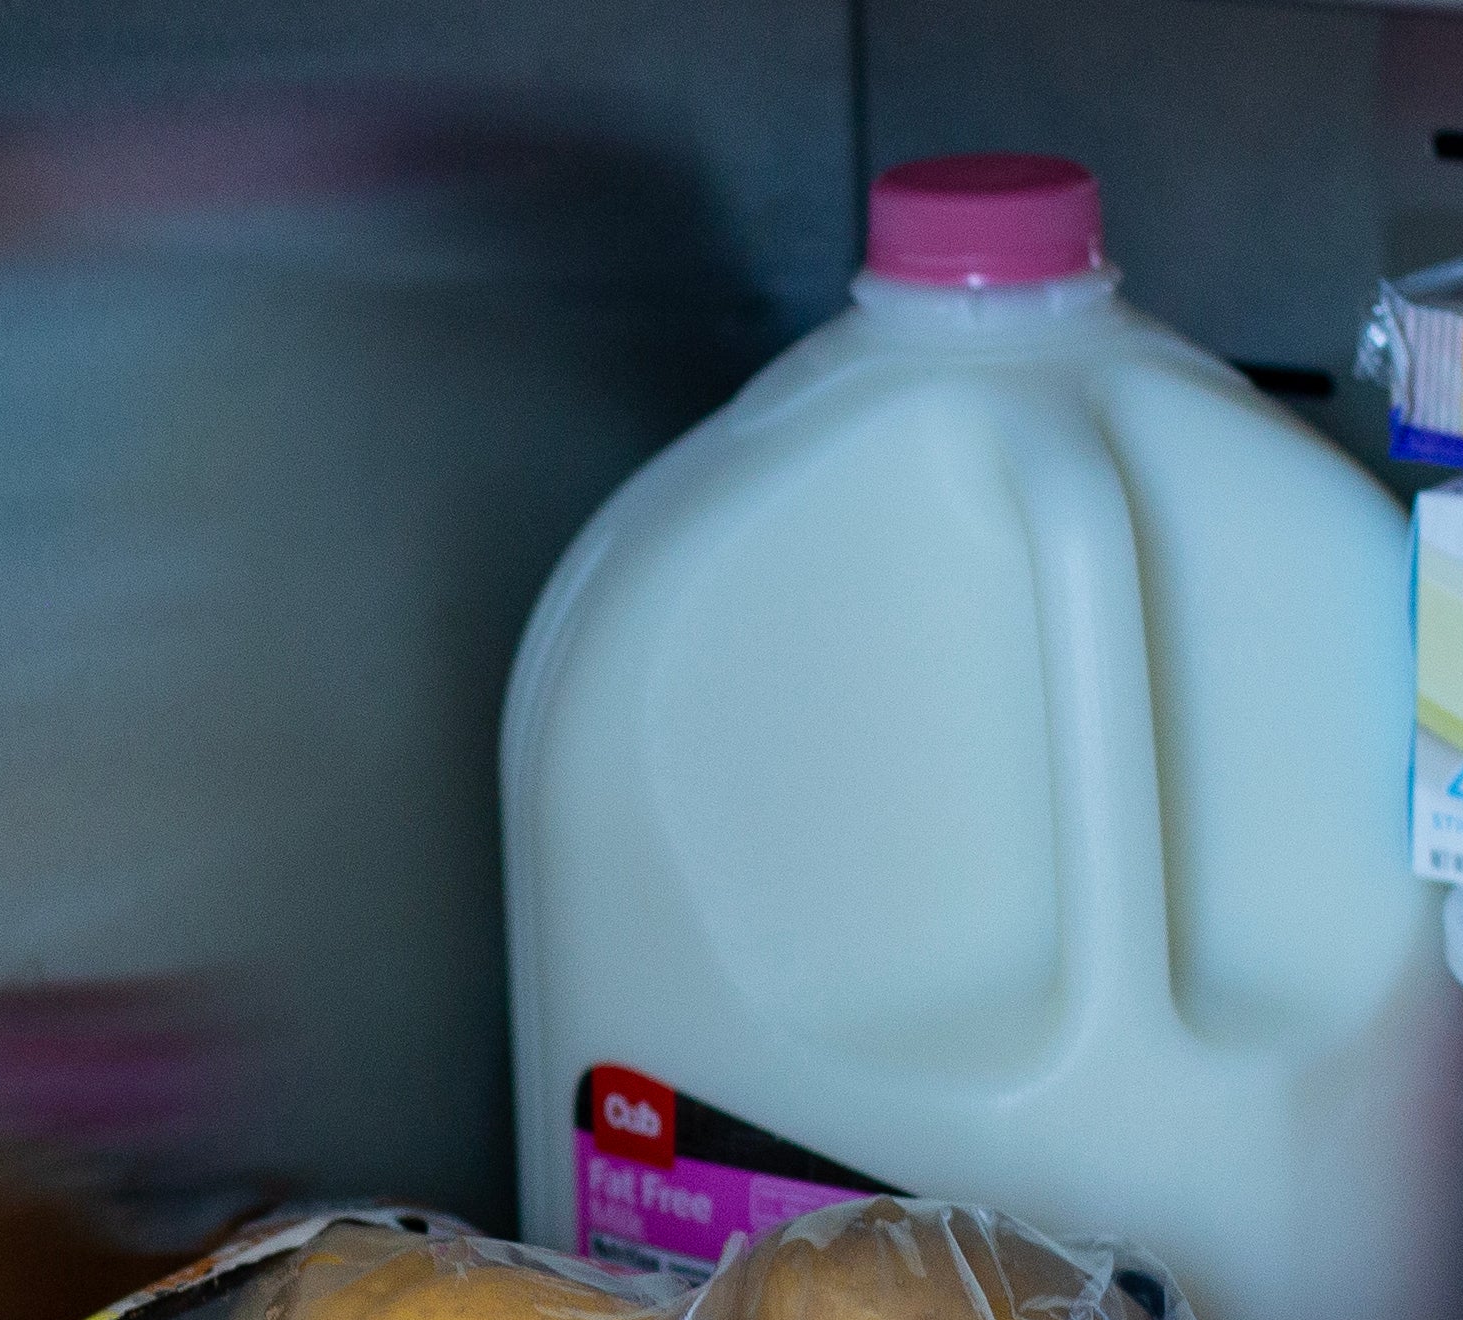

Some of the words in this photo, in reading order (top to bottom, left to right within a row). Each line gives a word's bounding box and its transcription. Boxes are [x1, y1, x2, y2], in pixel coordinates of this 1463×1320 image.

[603, 1092, 662, 1138] Cub
[588, 1156, 634, 1201] Fat
[640, 1171, 714, 1225] Free
